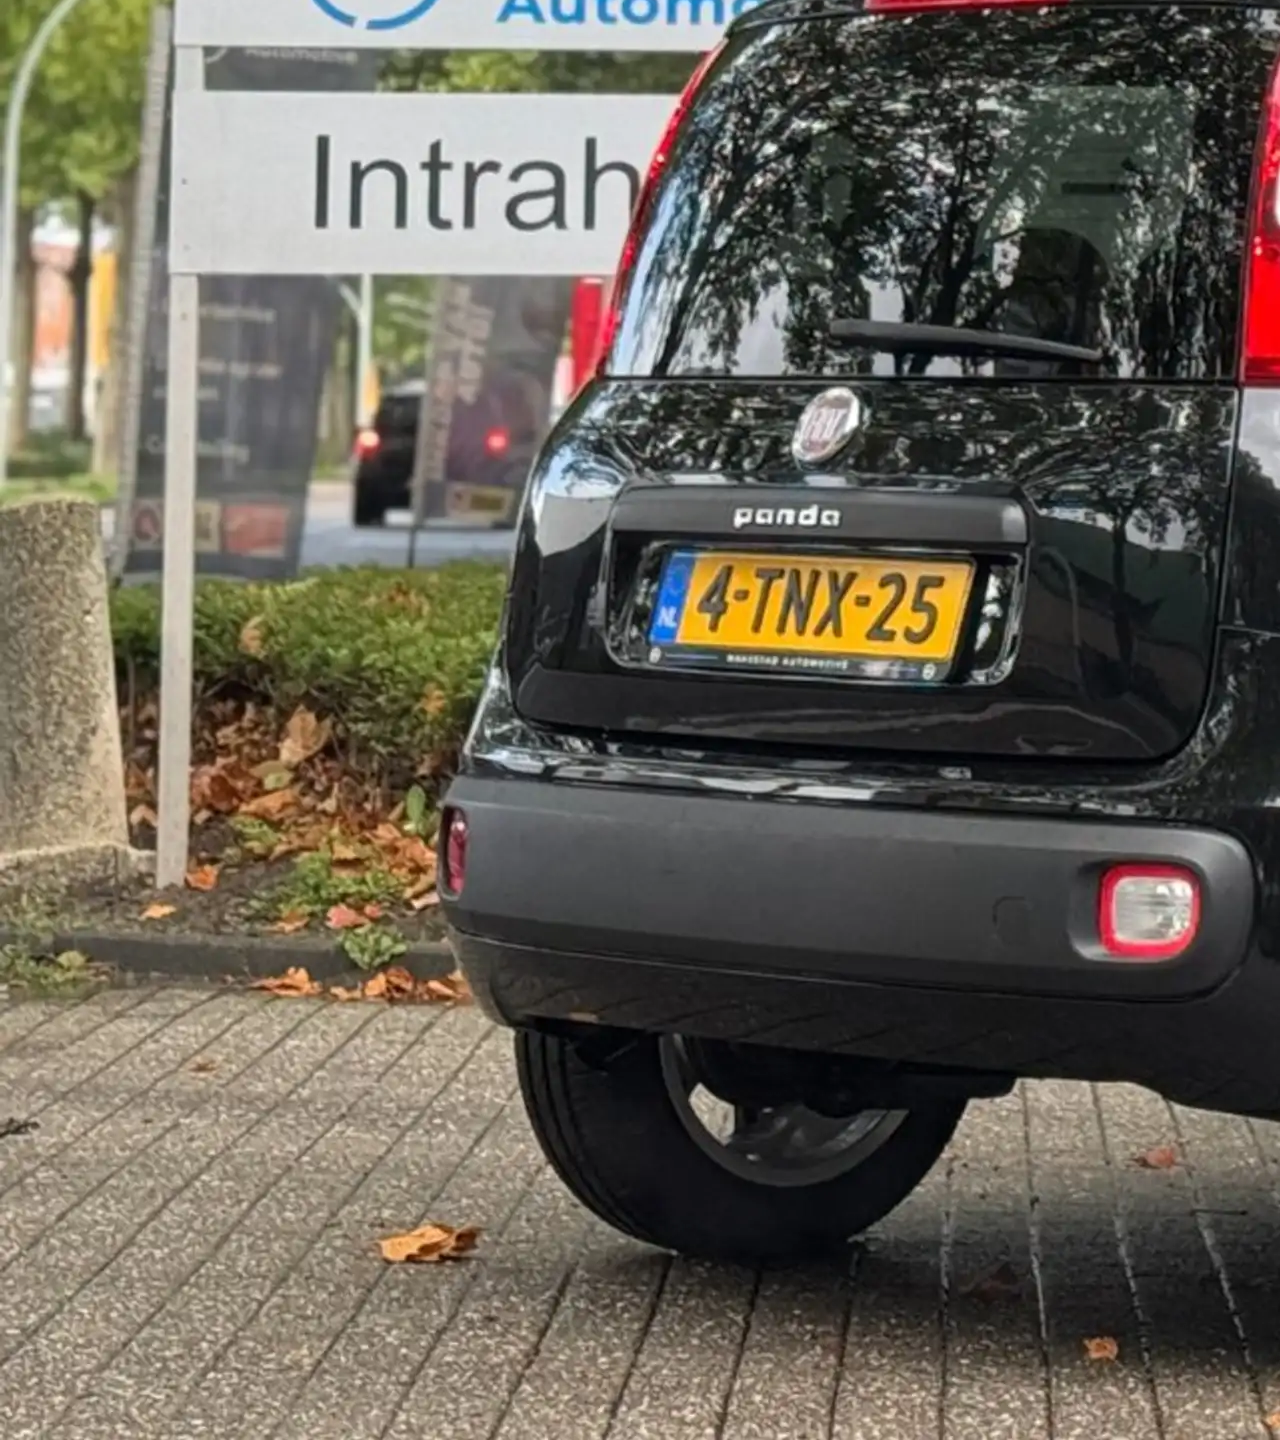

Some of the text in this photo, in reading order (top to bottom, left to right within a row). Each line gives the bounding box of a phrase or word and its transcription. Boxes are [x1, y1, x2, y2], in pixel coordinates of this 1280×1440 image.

[314, 134, 641, 231] Intrah
[733, 503, 841, 529] panda
[657, 564, 945, 645] NL 4-TNX-25
